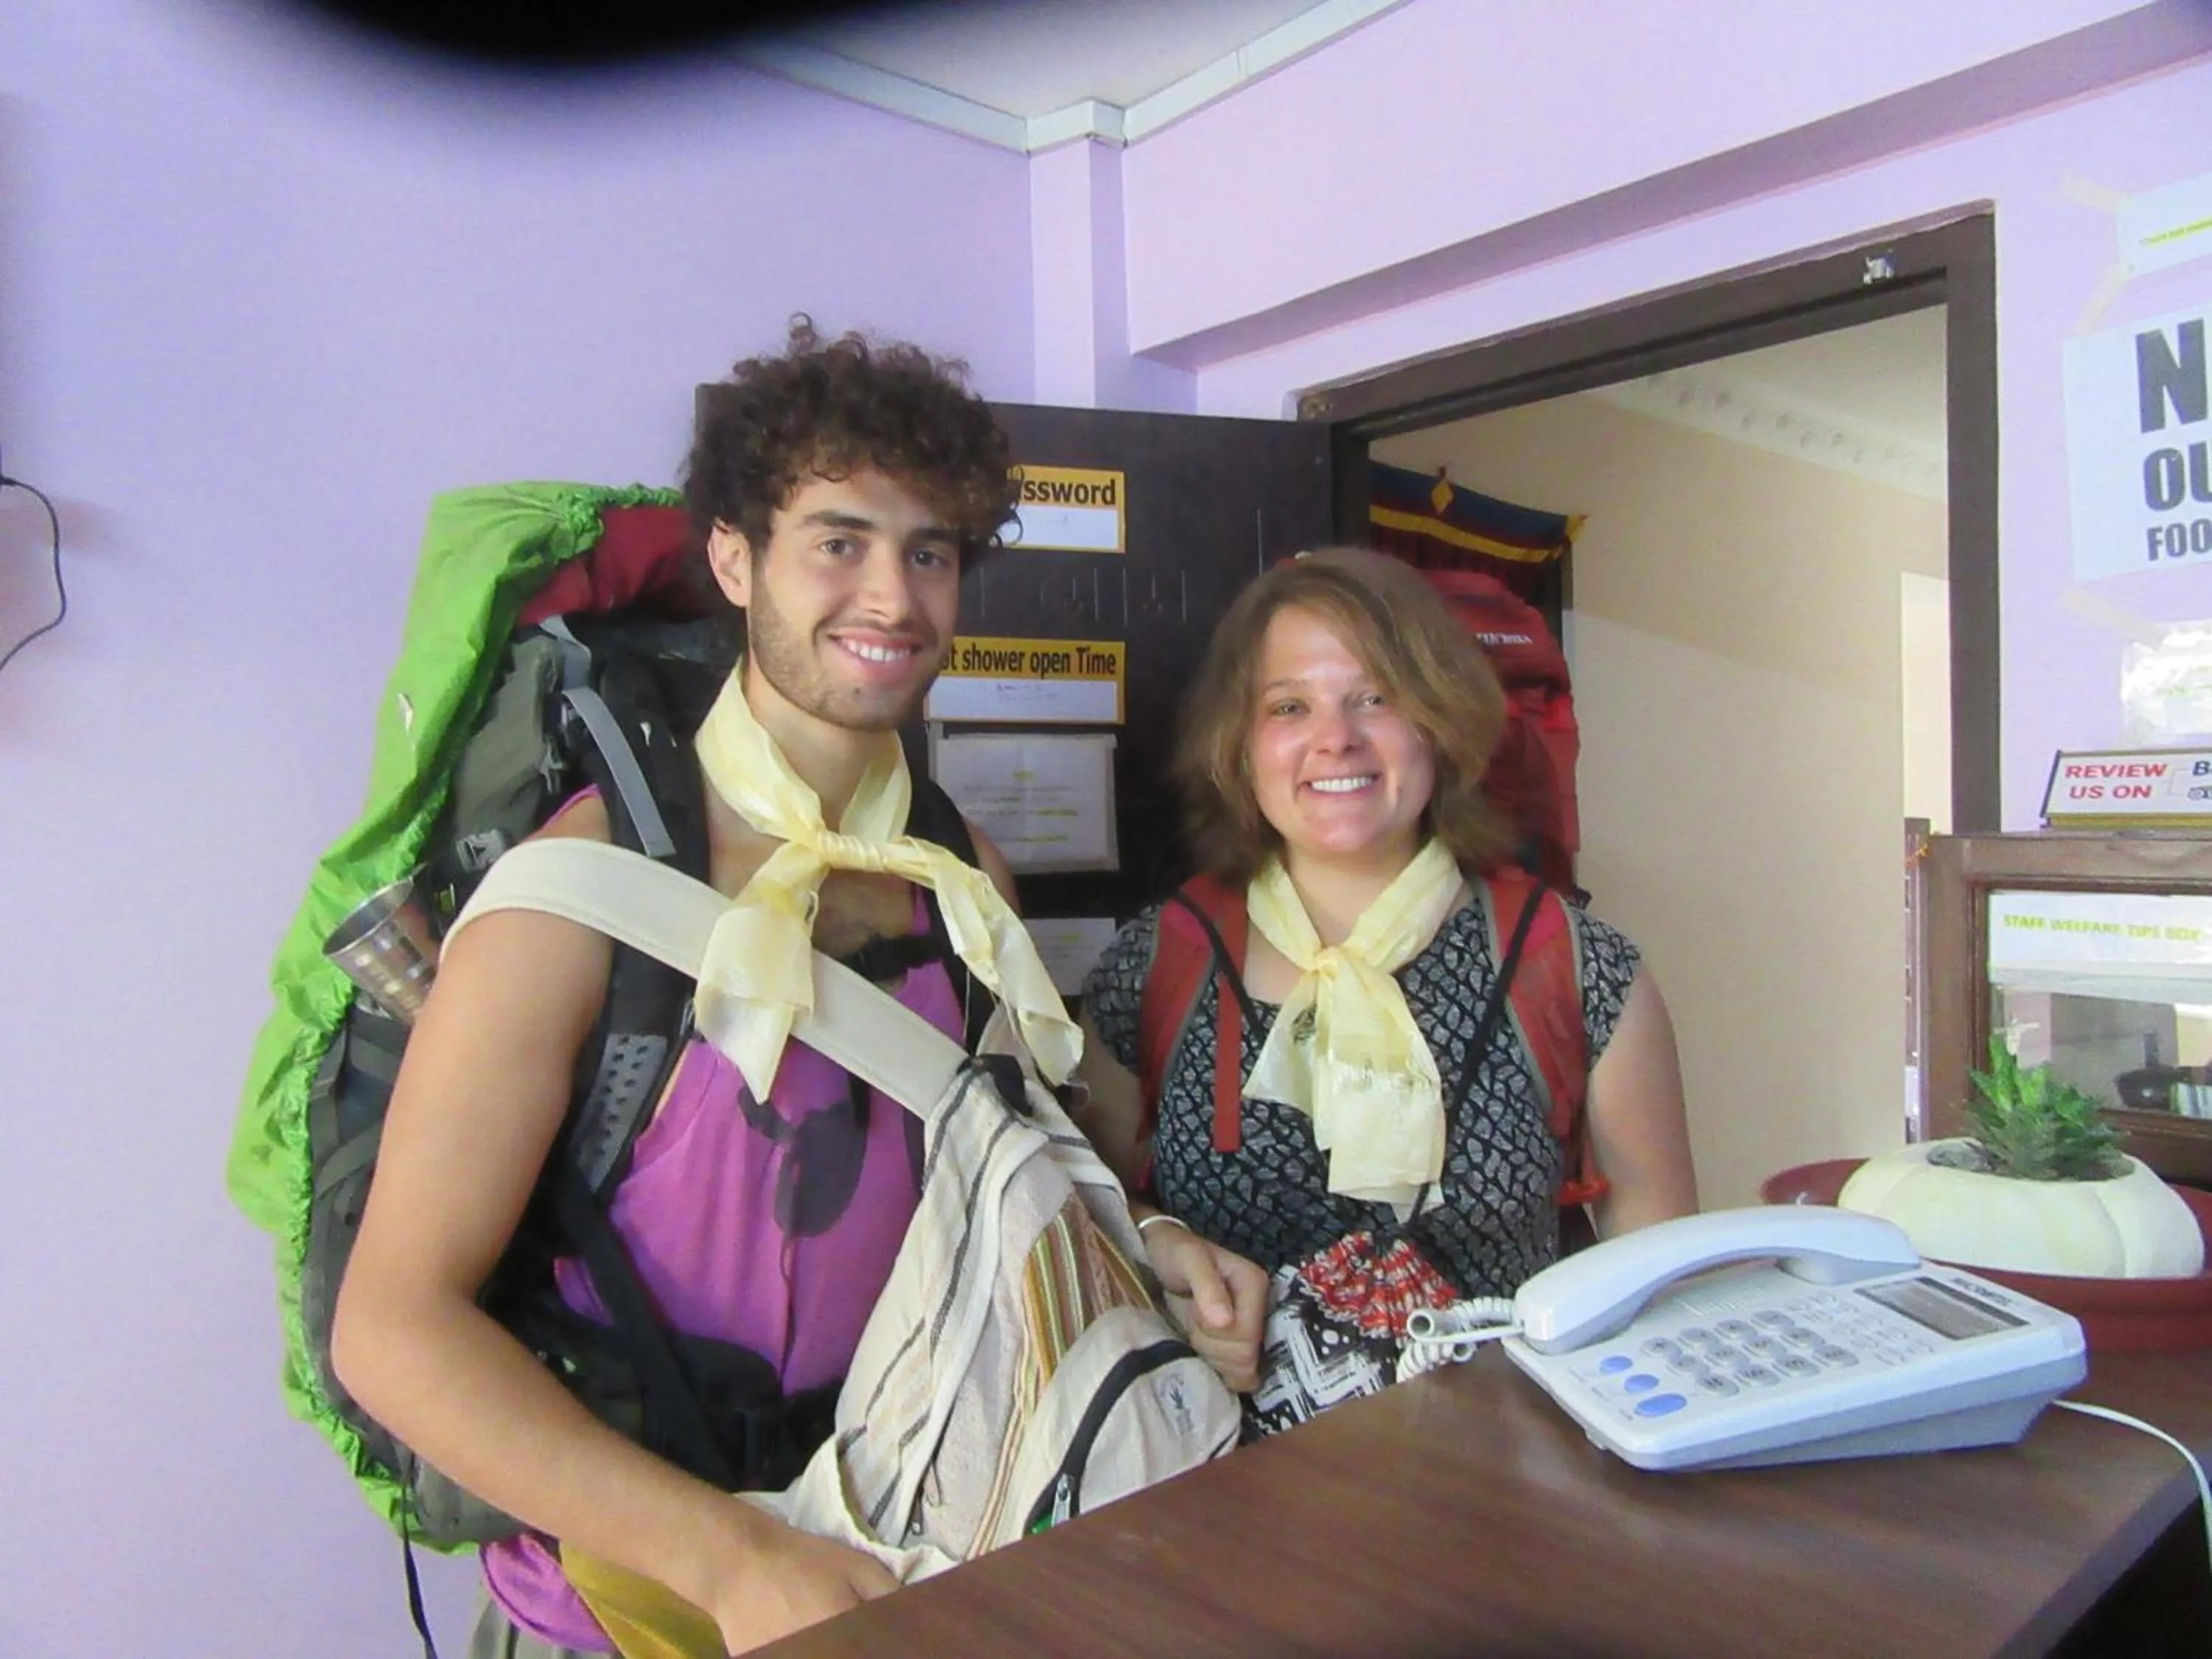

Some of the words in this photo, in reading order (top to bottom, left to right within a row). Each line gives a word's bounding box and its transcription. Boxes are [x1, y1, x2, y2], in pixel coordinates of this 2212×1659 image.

[2135, 318, 2208, 434] N
[1020, 478, 1116, 505] ssword
[962, 641, 1025, 673] shower
[1029, 651, 1071, 681] open
[1076, 645, 1116, 675] Time
[2065, 764, 2168, 779] REVIEW
[2192, 760, 2212, 777] B
[2069, 785, 2104, 799] US
[2112, 785, 2153, 799] ON
[2003, 915, 2045, 928] STAFF
[2051, 919, 2123, 933] WELFARE
[2128, 925, 2160, 938] TIPS
